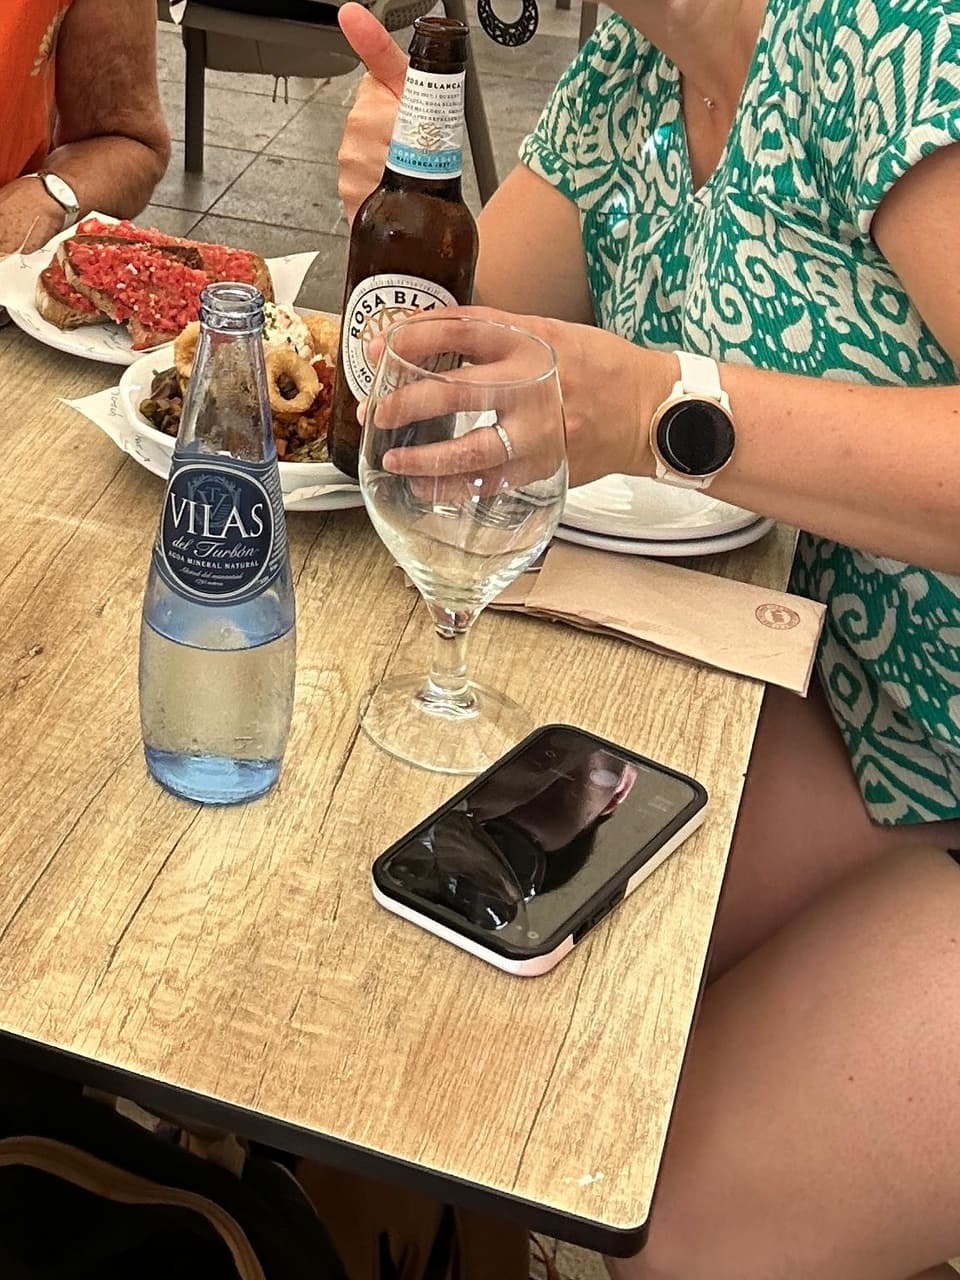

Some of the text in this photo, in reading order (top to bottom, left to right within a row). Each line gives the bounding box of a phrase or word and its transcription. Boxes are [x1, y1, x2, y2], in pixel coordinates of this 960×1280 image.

[351, 293, 386, 340] ROSA
[169, 492, 264, 539] VILAS
[171, 535, 259, 558] del Turbón
[186, 558, 222, 569] MINERAL
[224, 561, 260, 570] NATURAL
